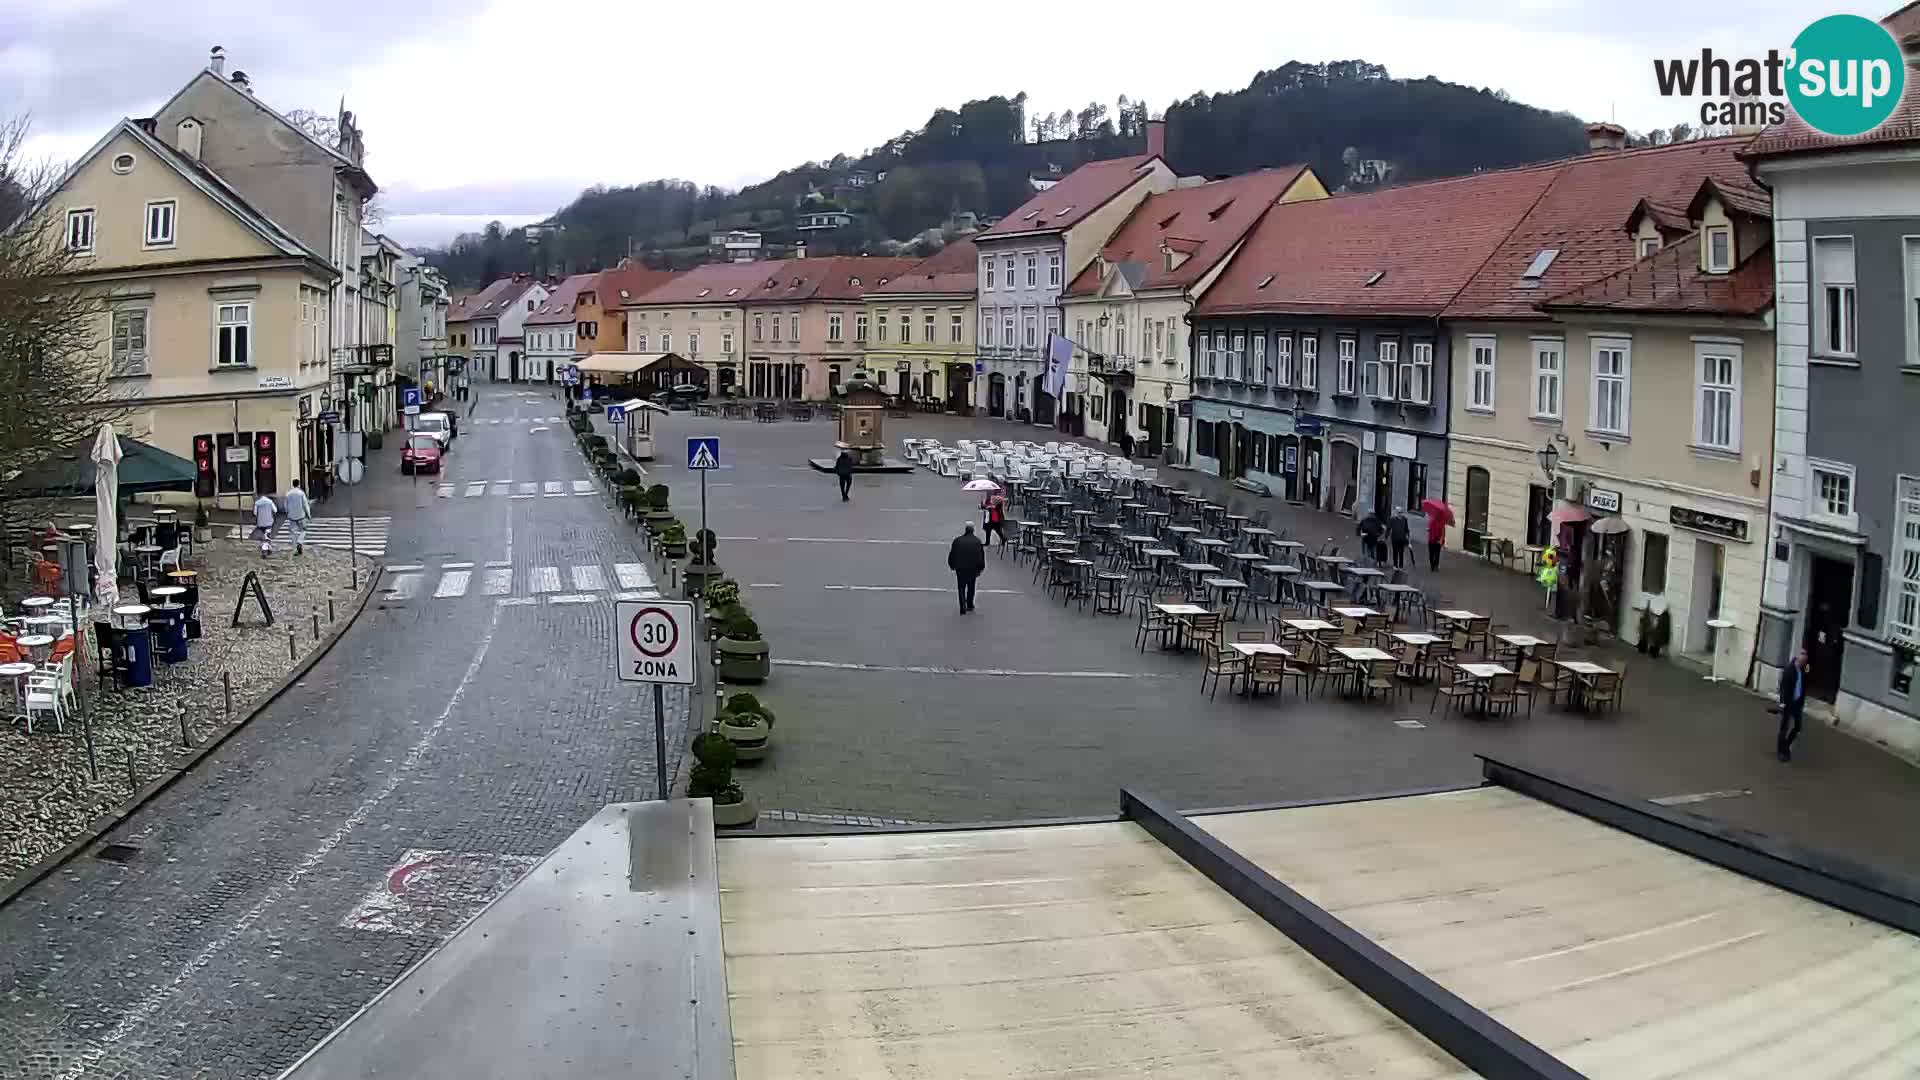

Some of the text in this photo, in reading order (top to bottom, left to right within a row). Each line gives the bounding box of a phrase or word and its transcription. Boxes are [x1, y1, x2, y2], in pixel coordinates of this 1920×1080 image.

[408, 392, 416, 404] P
[643, 623, 667, 644] 30
[633, 660, 678, 677] ZONA
